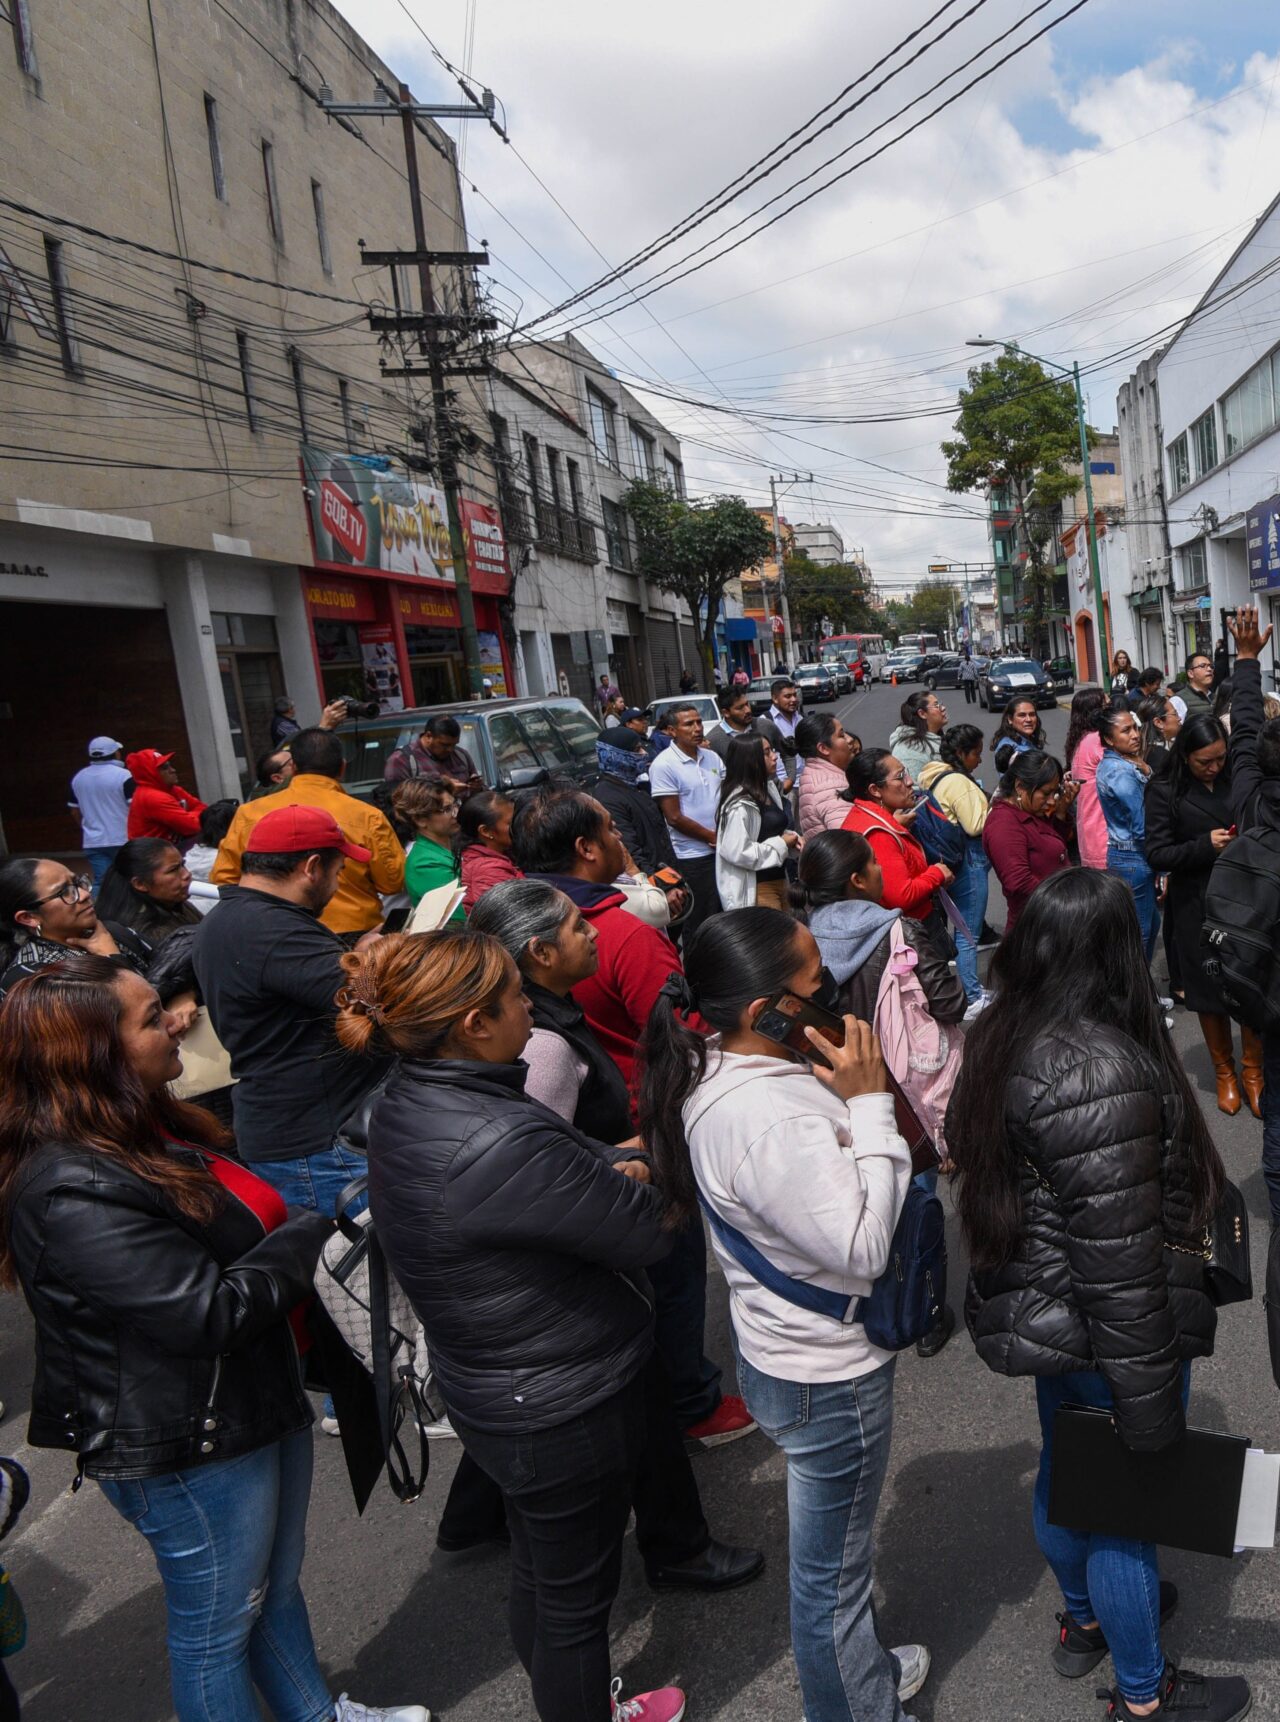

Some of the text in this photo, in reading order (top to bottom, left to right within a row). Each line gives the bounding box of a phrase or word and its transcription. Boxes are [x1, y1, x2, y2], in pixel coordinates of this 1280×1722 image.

[324, 488, 362, 547] GOB.TV
[307, 587, 356, 608] ORATORIO
[420, 602, 455, 618] MEXICANA
